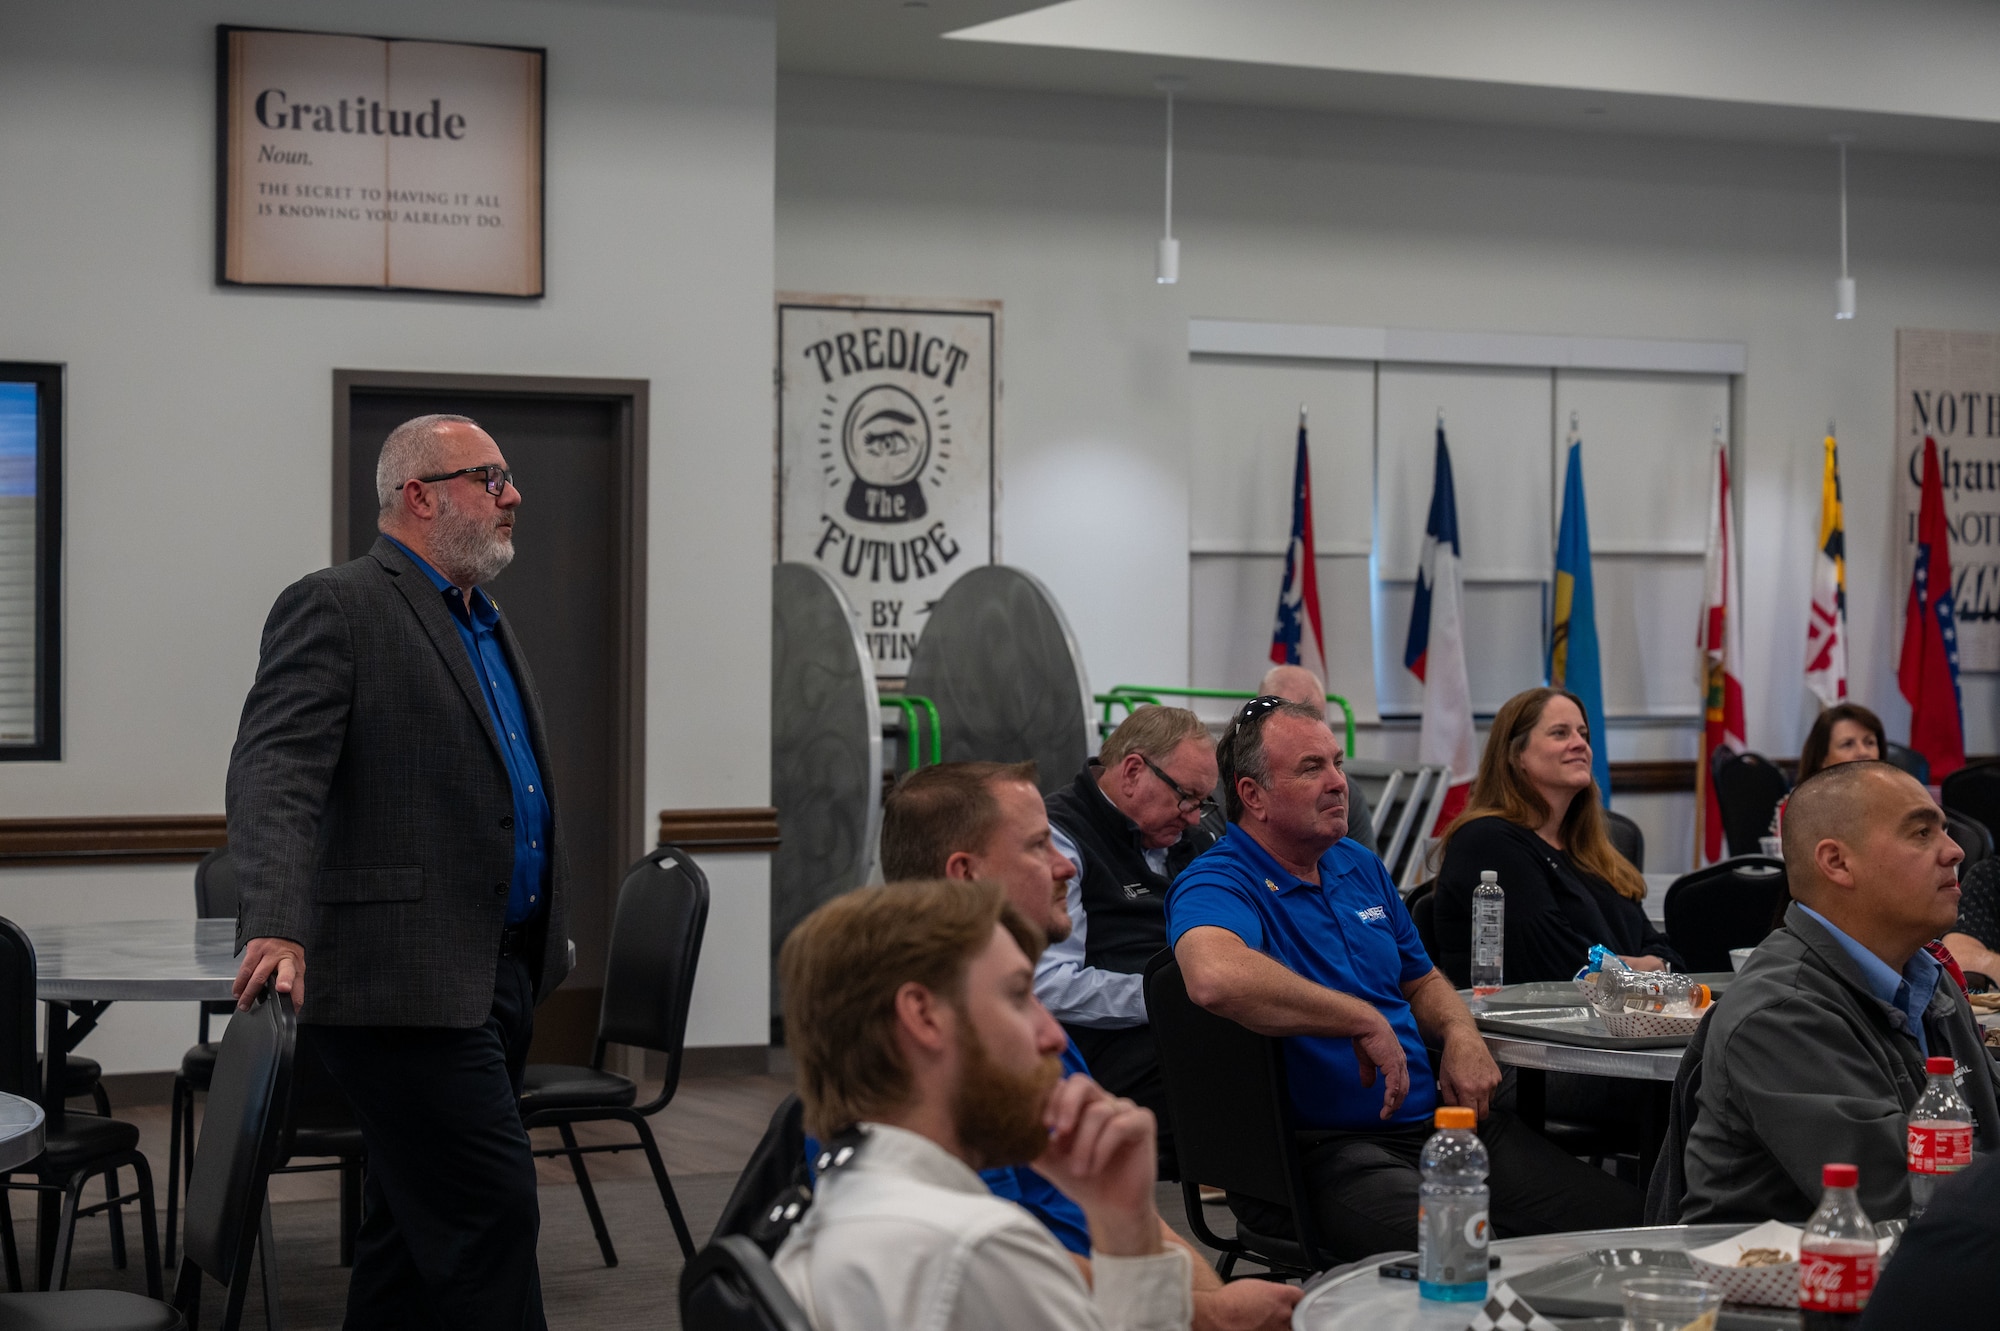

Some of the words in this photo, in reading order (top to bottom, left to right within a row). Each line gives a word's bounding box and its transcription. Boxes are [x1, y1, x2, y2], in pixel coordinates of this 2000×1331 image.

[254, 88, 467, 141] Gratitude
[257, 144, 313, 167] Noun.
[258, 182, 288, 197] THE
[296, 184, 351, 200] SECRET
[361, 188, 381, 201] TO
[386, 189, 449, 206] HAVING
[454, 192, 469, 206] IT
[475, 194, 500, 209] ALL
[258, 203, 273, 216] IS
[278, 203, 360, 221] KNOWING
[365, 207, 398, 222] YOU
[403, 210, 471, 227] ALREADY
[804, 327, 969, 388] PREDICT
[864, 488, 906, 518] The
[814, 514, 960, 584] FUTURE
[872, 600, 904, 628] BY
